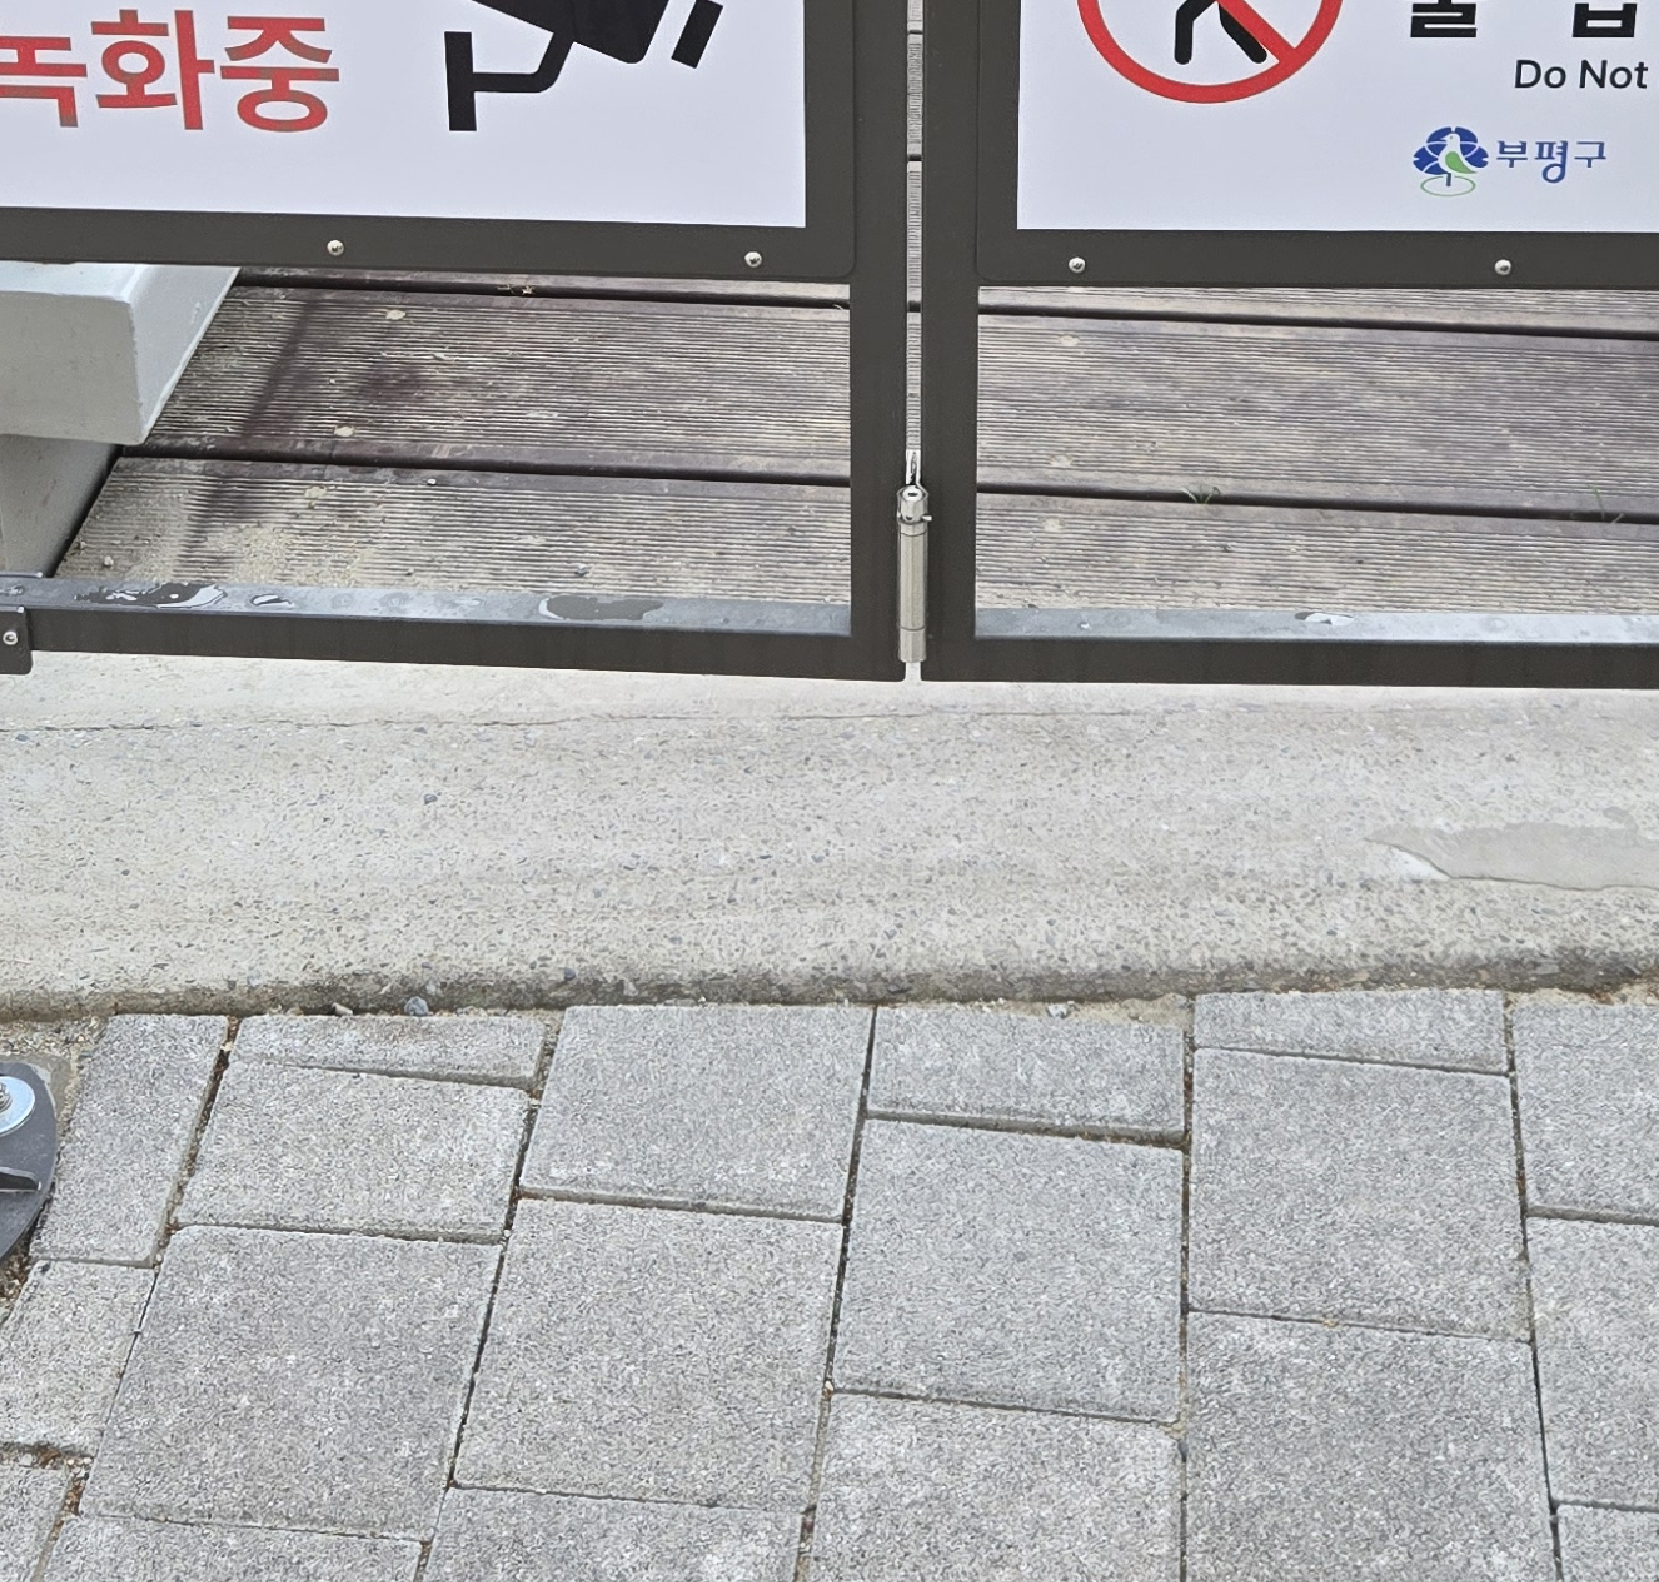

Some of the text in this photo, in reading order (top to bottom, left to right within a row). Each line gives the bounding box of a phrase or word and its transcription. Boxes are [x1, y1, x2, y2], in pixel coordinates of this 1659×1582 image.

[1514, 59, 1567, 90] Do
[1578, 59, 1649, 90] Not
[1495, 139, 1607, 184] 부평구
